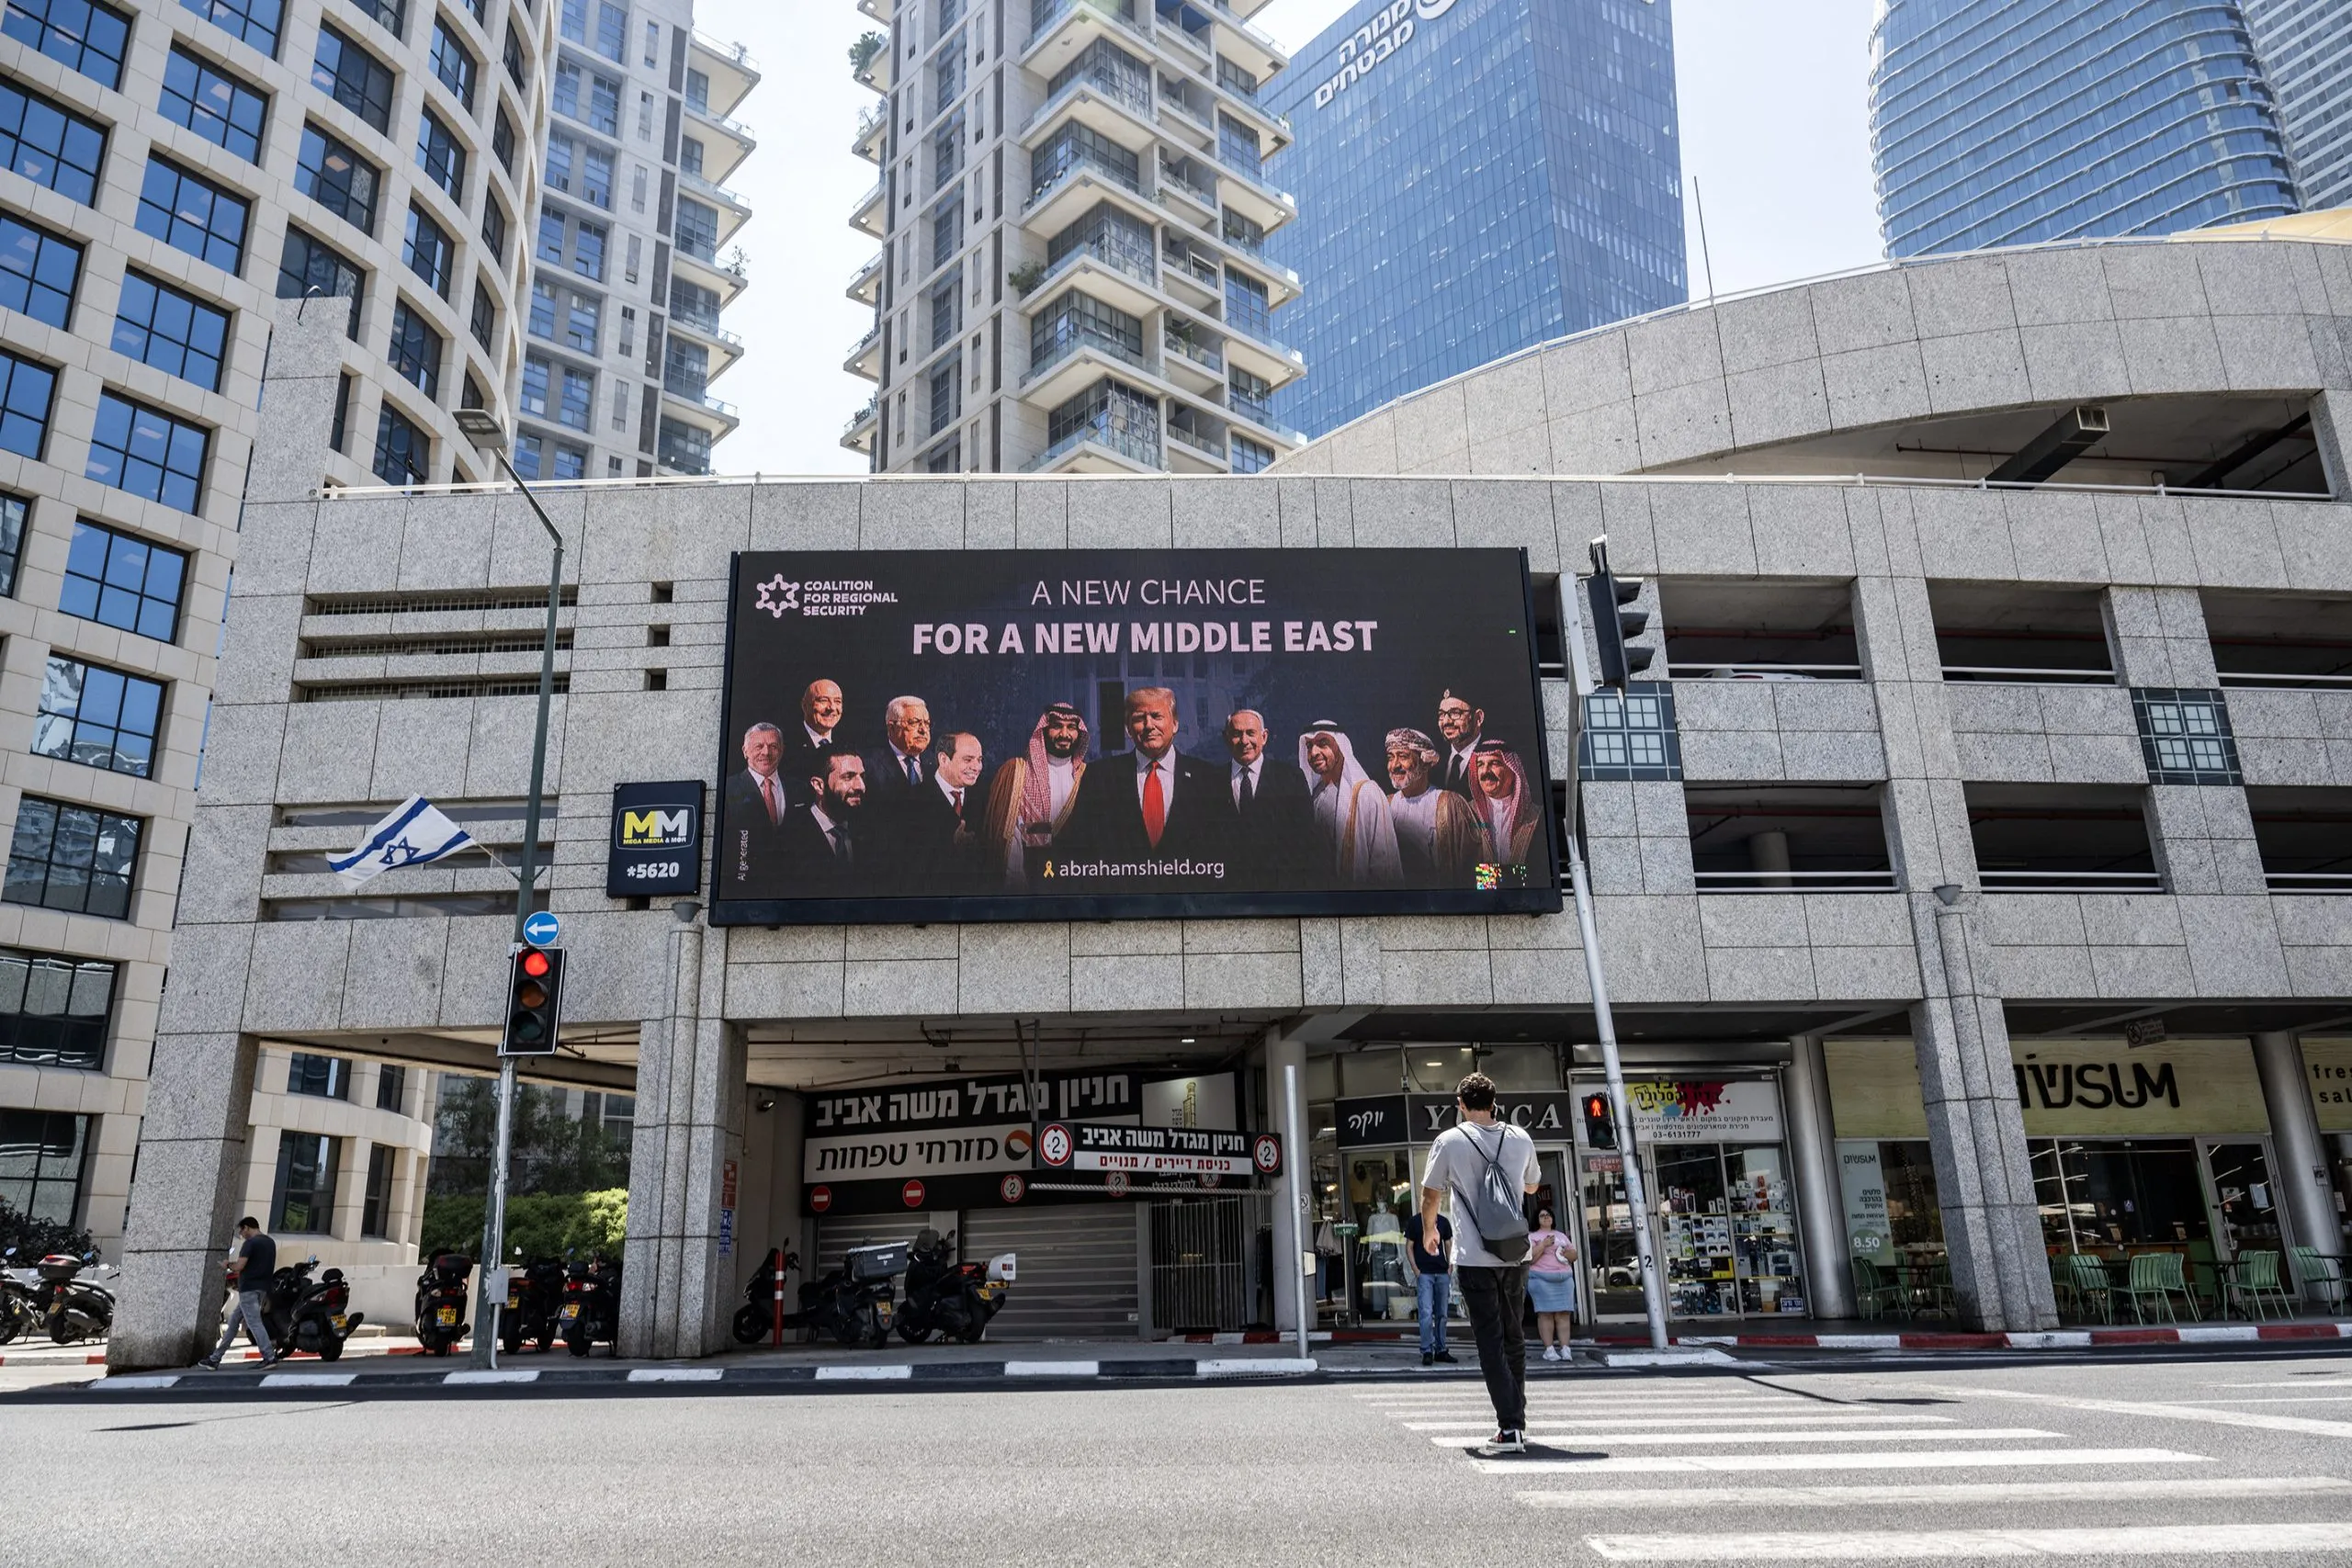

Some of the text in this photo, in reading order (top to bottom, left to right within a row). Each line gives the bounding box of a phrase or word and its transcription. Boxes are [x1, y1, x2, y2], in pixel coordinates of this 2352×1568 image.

[1339, 0, 1412, 65] מנורה
[1314, 19, 1414, 110] מבטחים
[803, 580, 874, 591] COALITION
[1031, 579, 1266, 605] A NEW CHANCE
[803, 592, 899, 604] FOR REGIONAL
[802, 605, 866, 616] SECURITY
[912, 621, 1379, 655] FOR A NEW MIDDLE EAST
[623, 809, 689, 839] MM
[739, 829, 750, 872] generated
[1059, 858, 1226, 880] abrahamshield.org
[2312, 1064, 2352, 1079] fre
[816, 1074, 1129, 1127] חניון מגדל משה אביב
[1348, 1110, 1385, 1138] יוקה
[1424, 1102, 1564, 1131] YCA
[1052, 1135, 1060, 1154] 2
[1081, 1126, 1245, 1155] חניון מגדל משה אביב
[816, 1137, 1000, 1171] מזרחי טפחות
[1100, 1155, 1138, 1168] מנויים
[1154, 1157, 1193, 1169] דיירים
[1263, 1145, 1271, 1162] 2
[1196, 1159, 1231, 1171] כניסת
[1009, 1182, 1016, 1194] 2
[1853, 1236, 1881, 1248] 8.50
